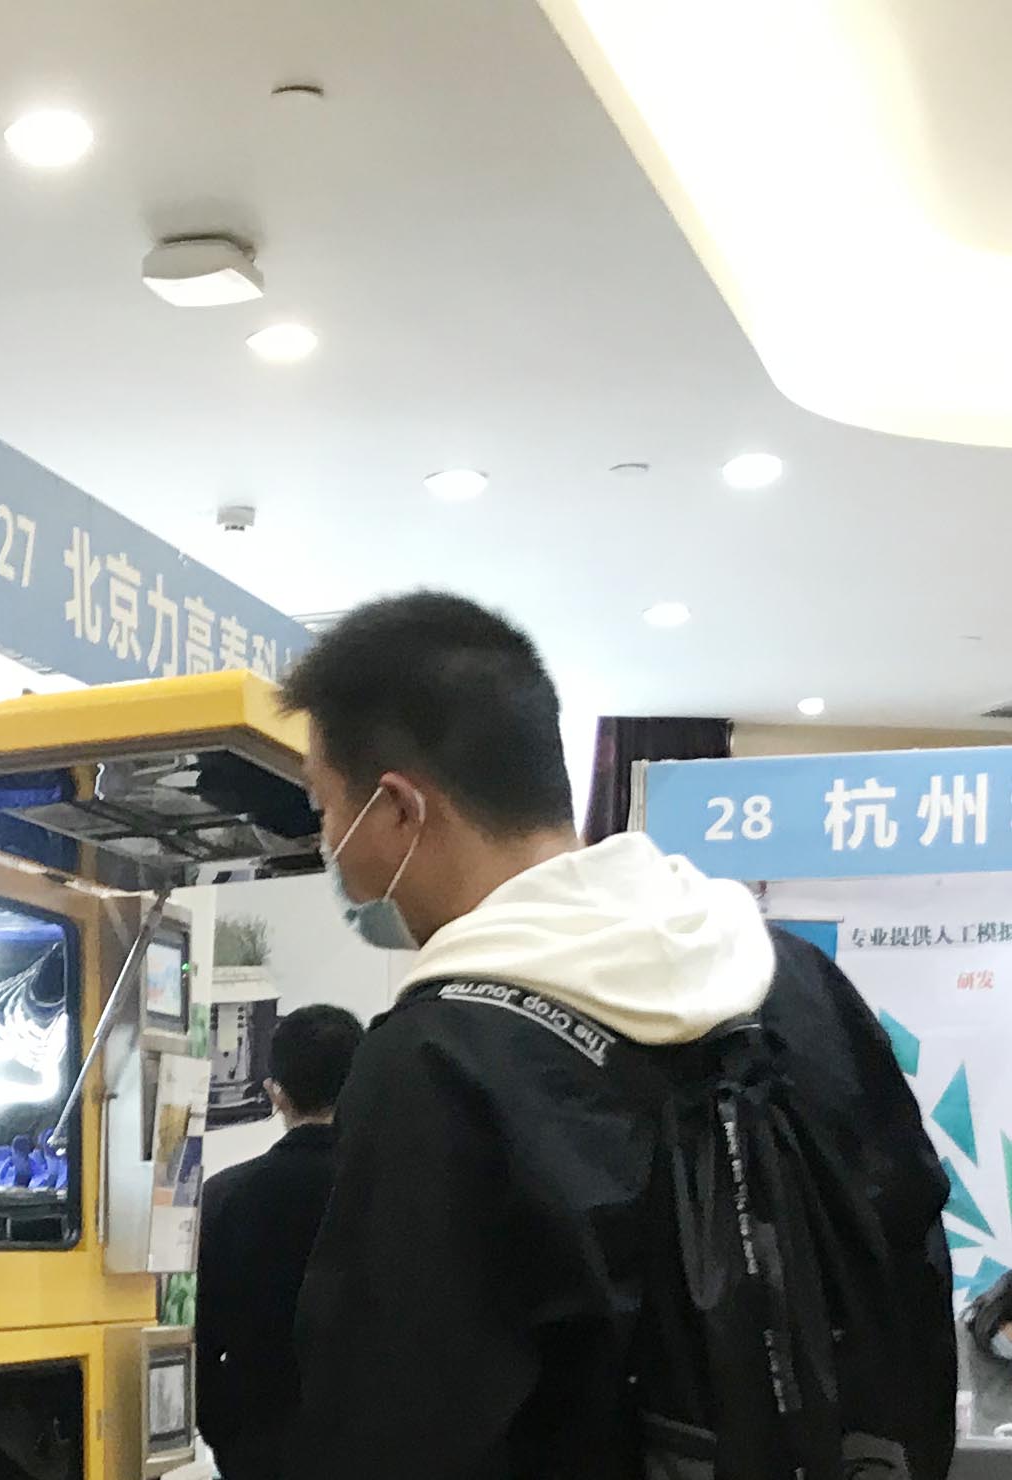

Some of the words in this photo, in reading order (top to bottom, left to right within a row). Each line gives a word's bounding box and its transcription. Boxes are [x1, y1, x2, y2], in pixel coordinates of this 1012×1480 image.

[63, 524, 292, 686] 北京力高泰科
[704, 794, 773, 841] 28
[824, 772, 1012, 851] 杭州
[438, 982, 521, 1003] Journal
[956, 969, 995, 990] 研发
[522, 995, 572, 1031] Crop
[573, 1023, 608, 1058] The
